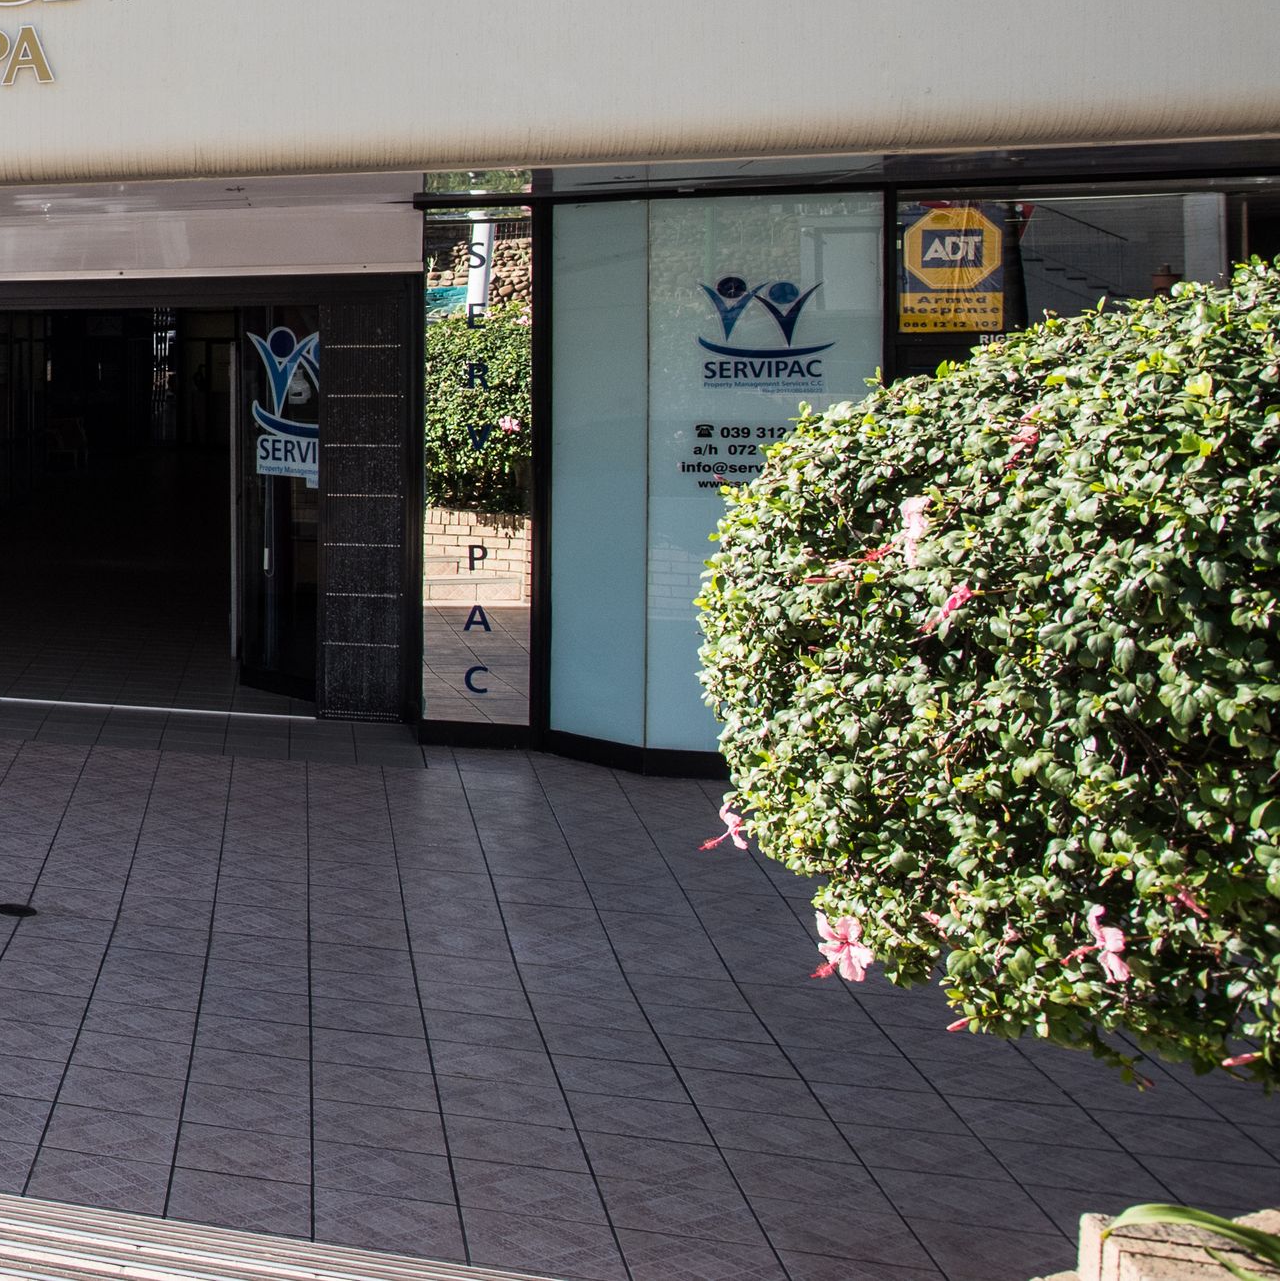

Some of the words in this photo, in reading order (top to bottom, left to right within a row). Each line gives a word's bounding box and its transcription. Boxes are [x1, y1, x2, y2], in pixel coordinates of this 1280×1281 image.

[922, 236, 982, 261] ADT
[917, 295, 987, 304] Armed
[903, 306, 999, 315] Response
[704, 359, 822, 379] SERVIPAC
[720, 427, 751, 438] 039
[756, 427, 787, 438] 312
[259, 438, 317, 464] SERVI
[693, 444, 718, 456] a/h
[728, 445, 757, 455] 072
[259, 464, 284, 475] Property
[284, 466, 318, 476] Manageme
[681, 462, 763, 475] info@serv
